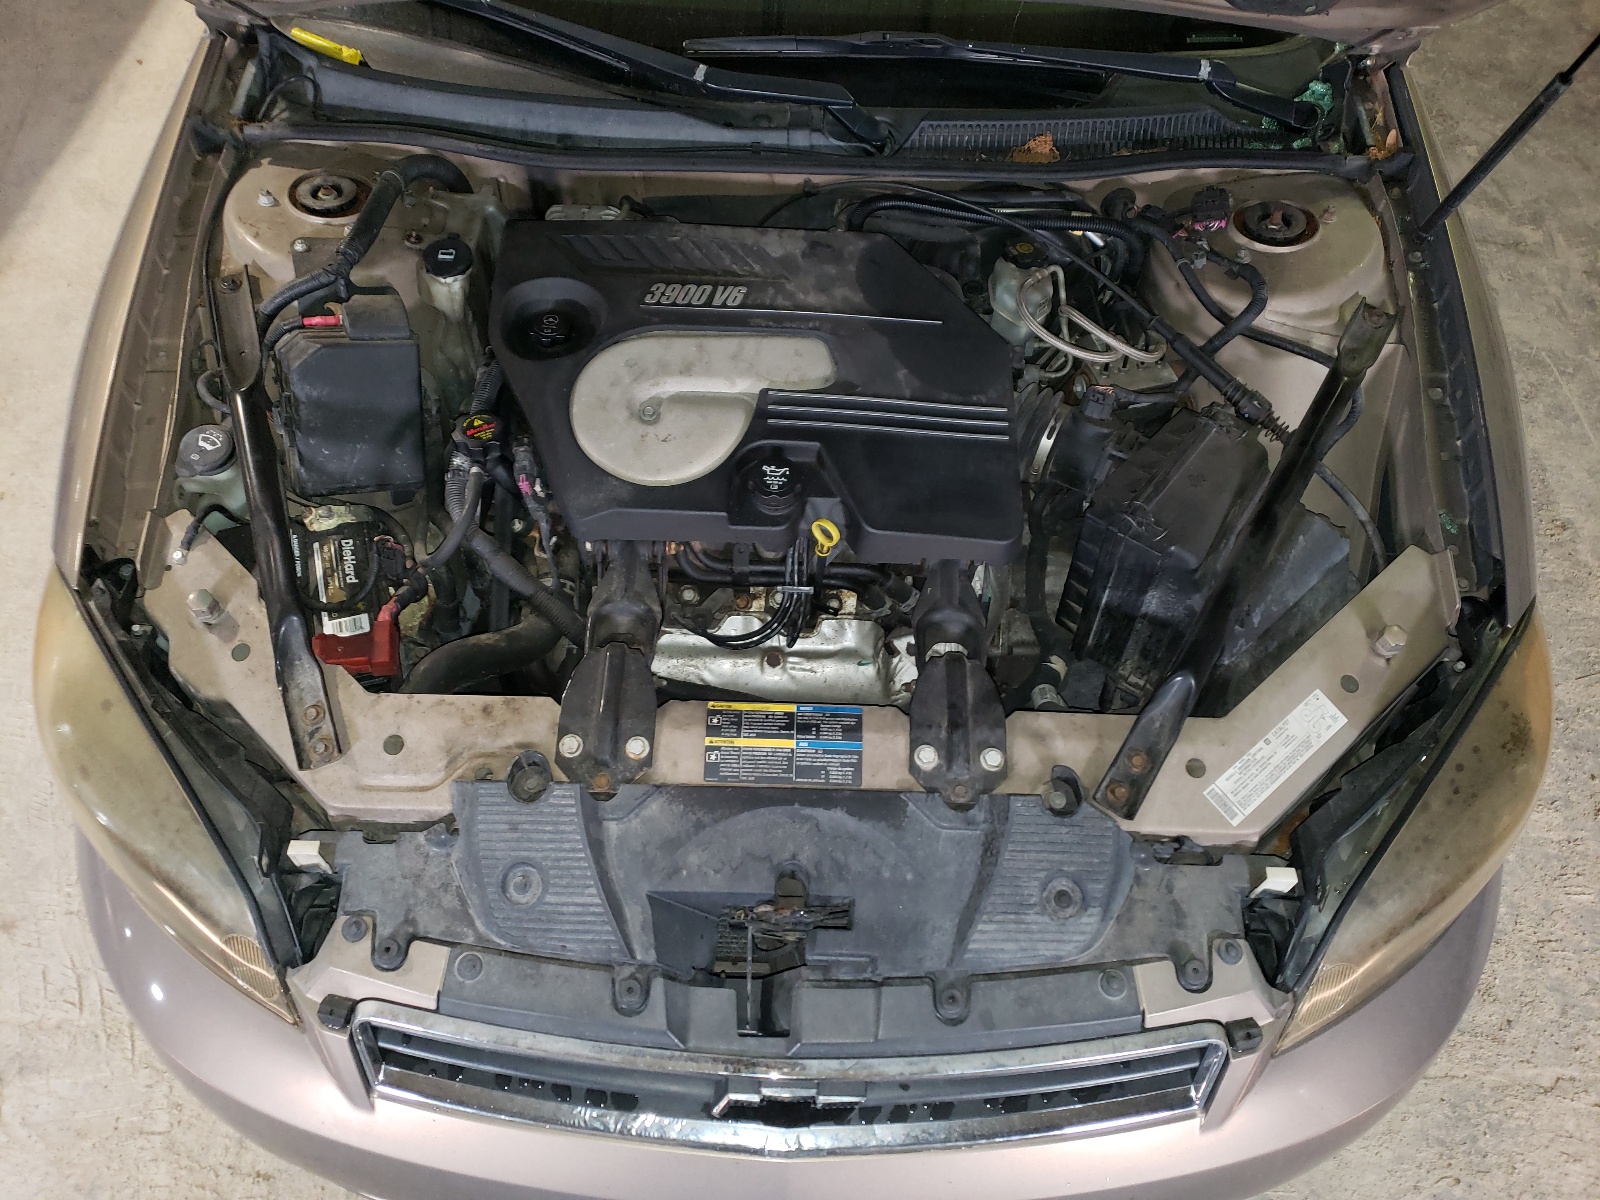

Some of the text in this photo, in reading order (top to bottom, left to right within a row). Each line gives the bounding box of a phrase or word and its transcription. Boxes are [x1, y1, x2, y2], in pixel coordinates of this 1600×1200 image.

[644, 283, 748, 306] 3900 V6
[340, 538, 359, 583] DieHard
